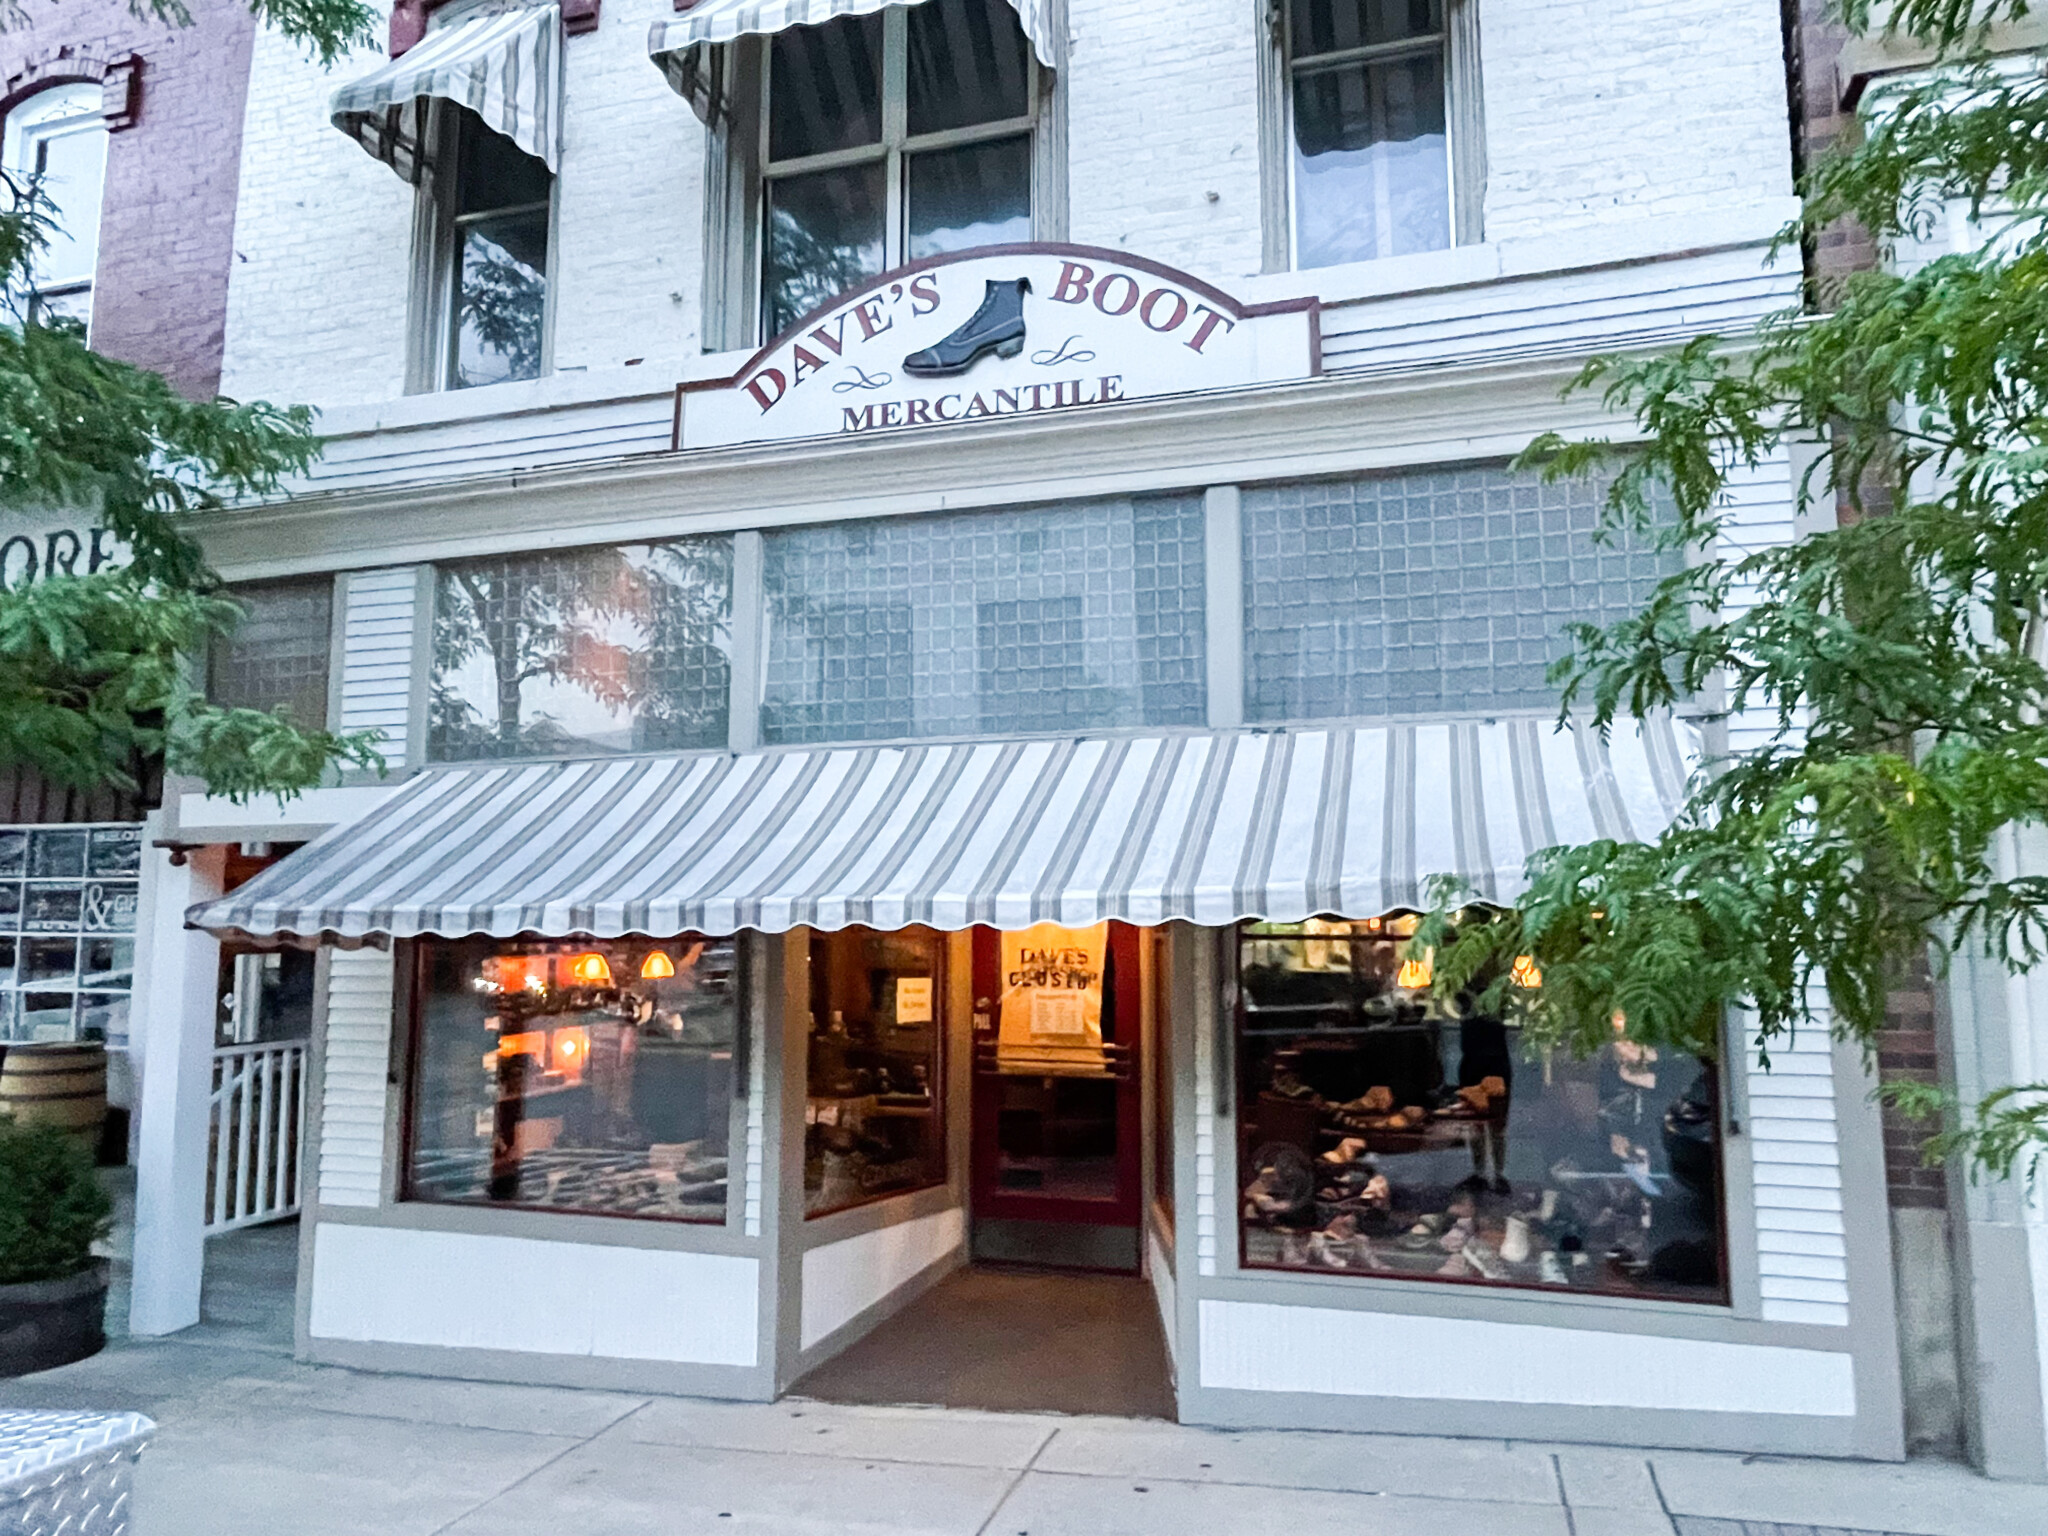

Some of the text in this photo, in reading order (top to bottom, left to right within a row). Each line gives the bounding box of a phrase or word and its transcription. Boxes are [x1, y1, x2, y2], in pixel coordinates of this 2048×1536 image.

[741, 260, 1236, 415] DAVE'S BOOT
[841, 374, 1125, 433] MERCANTILE
